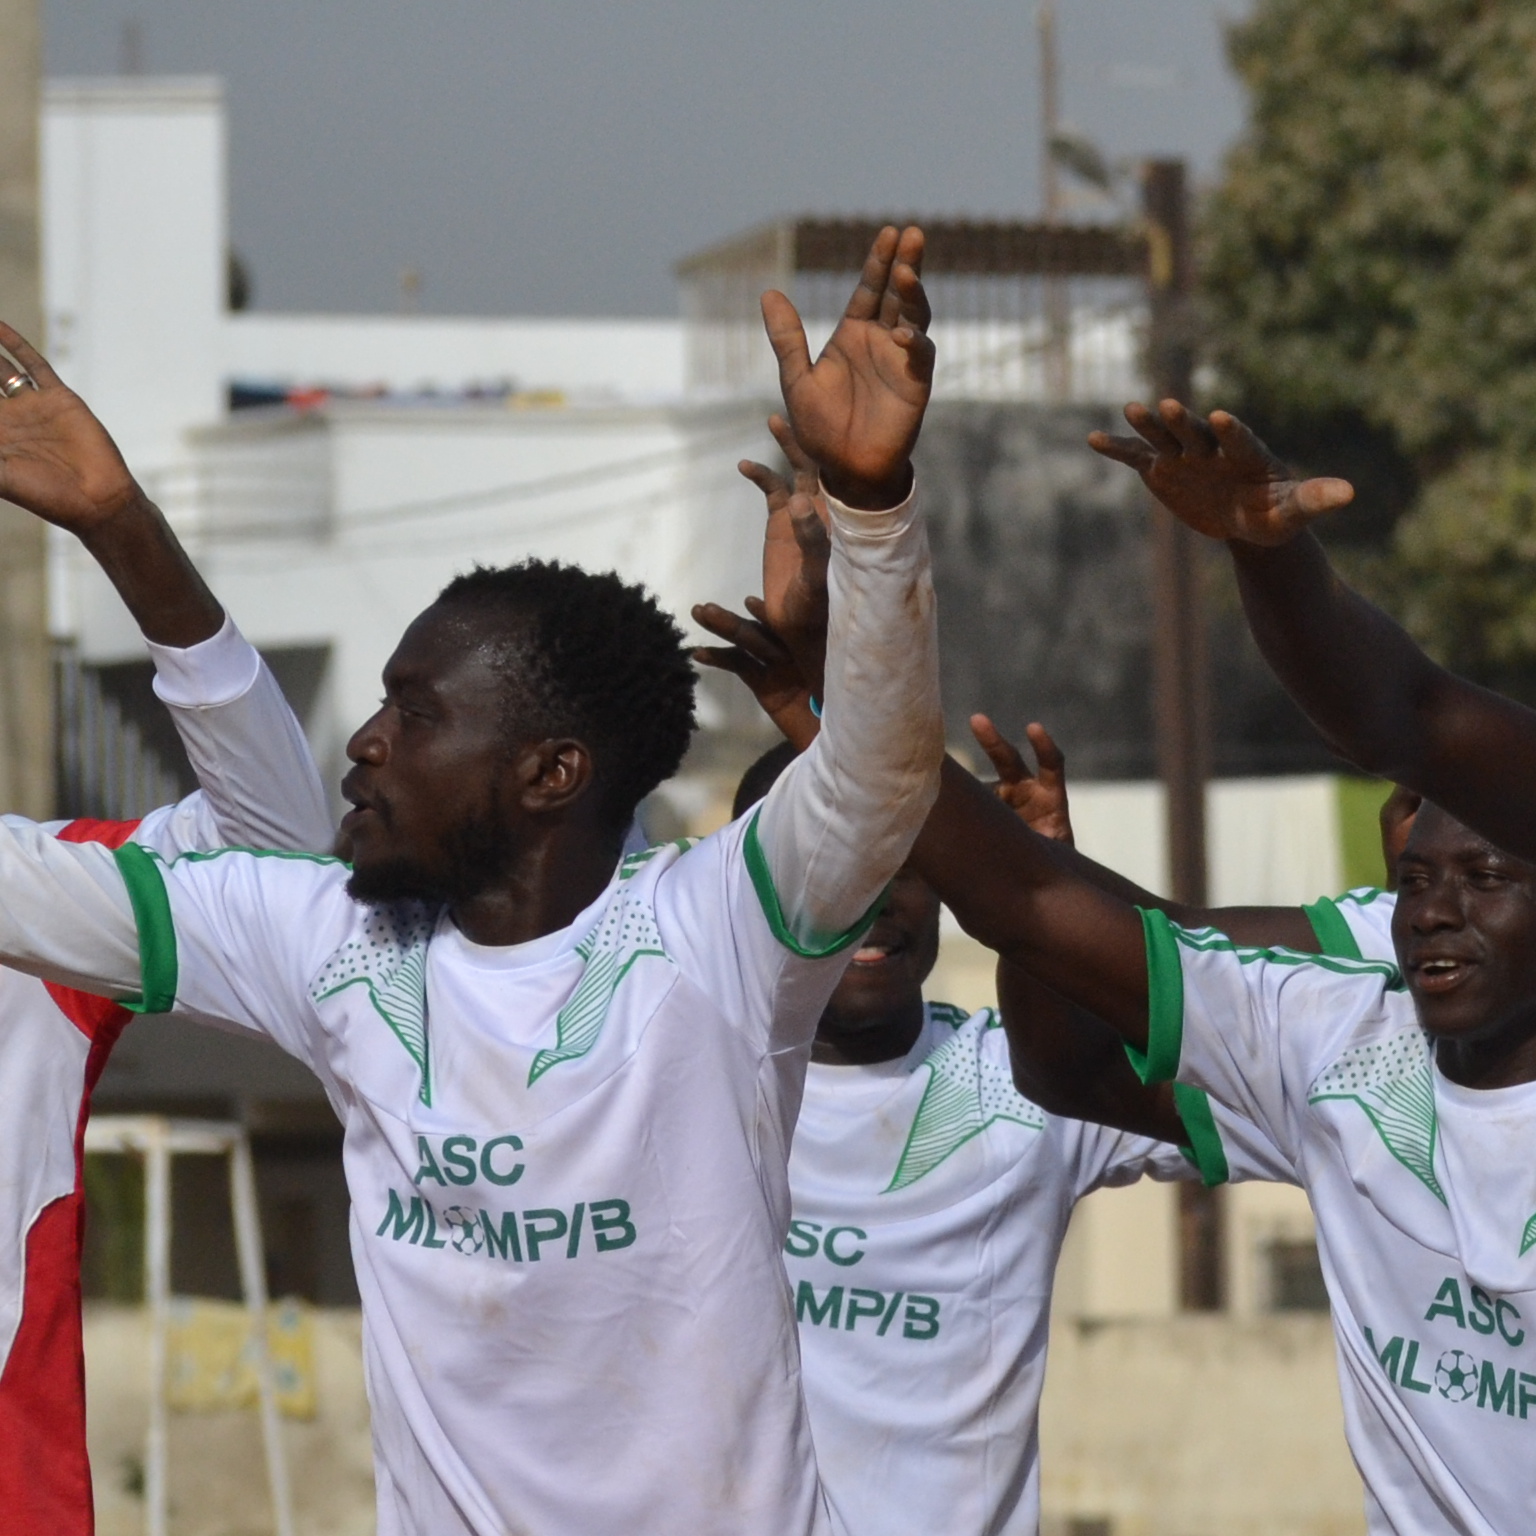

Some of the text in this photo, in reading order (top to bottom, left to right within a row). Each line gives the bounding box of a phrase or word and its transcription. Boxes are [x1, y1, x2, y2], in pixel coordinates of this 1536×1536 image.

[414, 1135, 526, 1187] ASC
[784, 1219, 868, 1267] SC
[793, 1280, 941, 1341] MP/B
[1423, 1277, 1526, 1348] ASC
